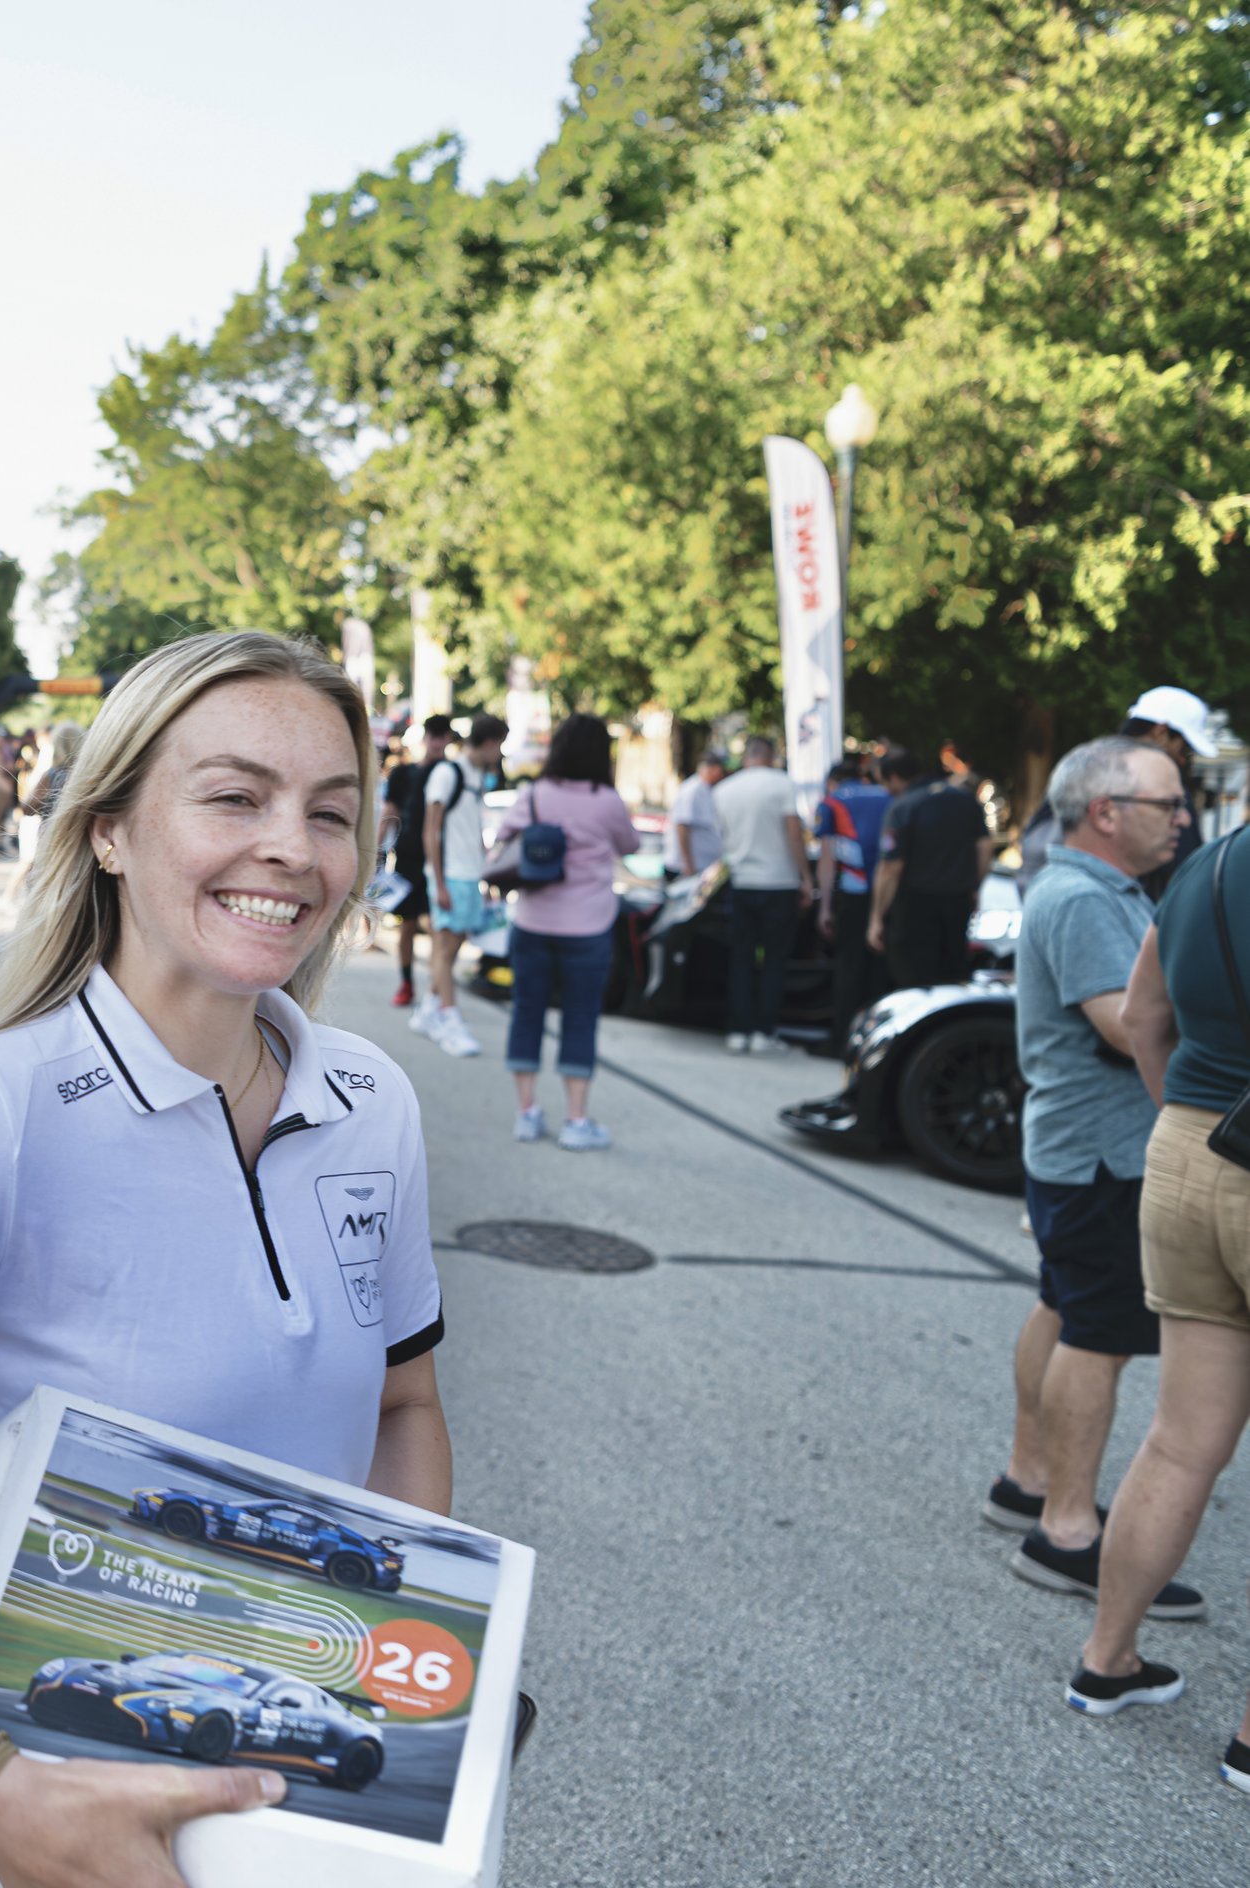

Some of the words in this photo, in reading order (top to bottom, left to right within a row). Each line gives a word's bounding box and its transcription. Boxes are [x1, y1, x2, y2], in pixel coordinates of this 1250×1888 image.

[57, 1067, 112, 1104] sparc
[338, 1211, 388, 1246] AMR
[98, 1565, 124, 1584] OF
[127, 1574, 198, 1608] RACING
[103, 1549, 138, 1574] THE
[141, 1562, 202, 1593] HEART
[372, 1641, 454, 1692] 26
